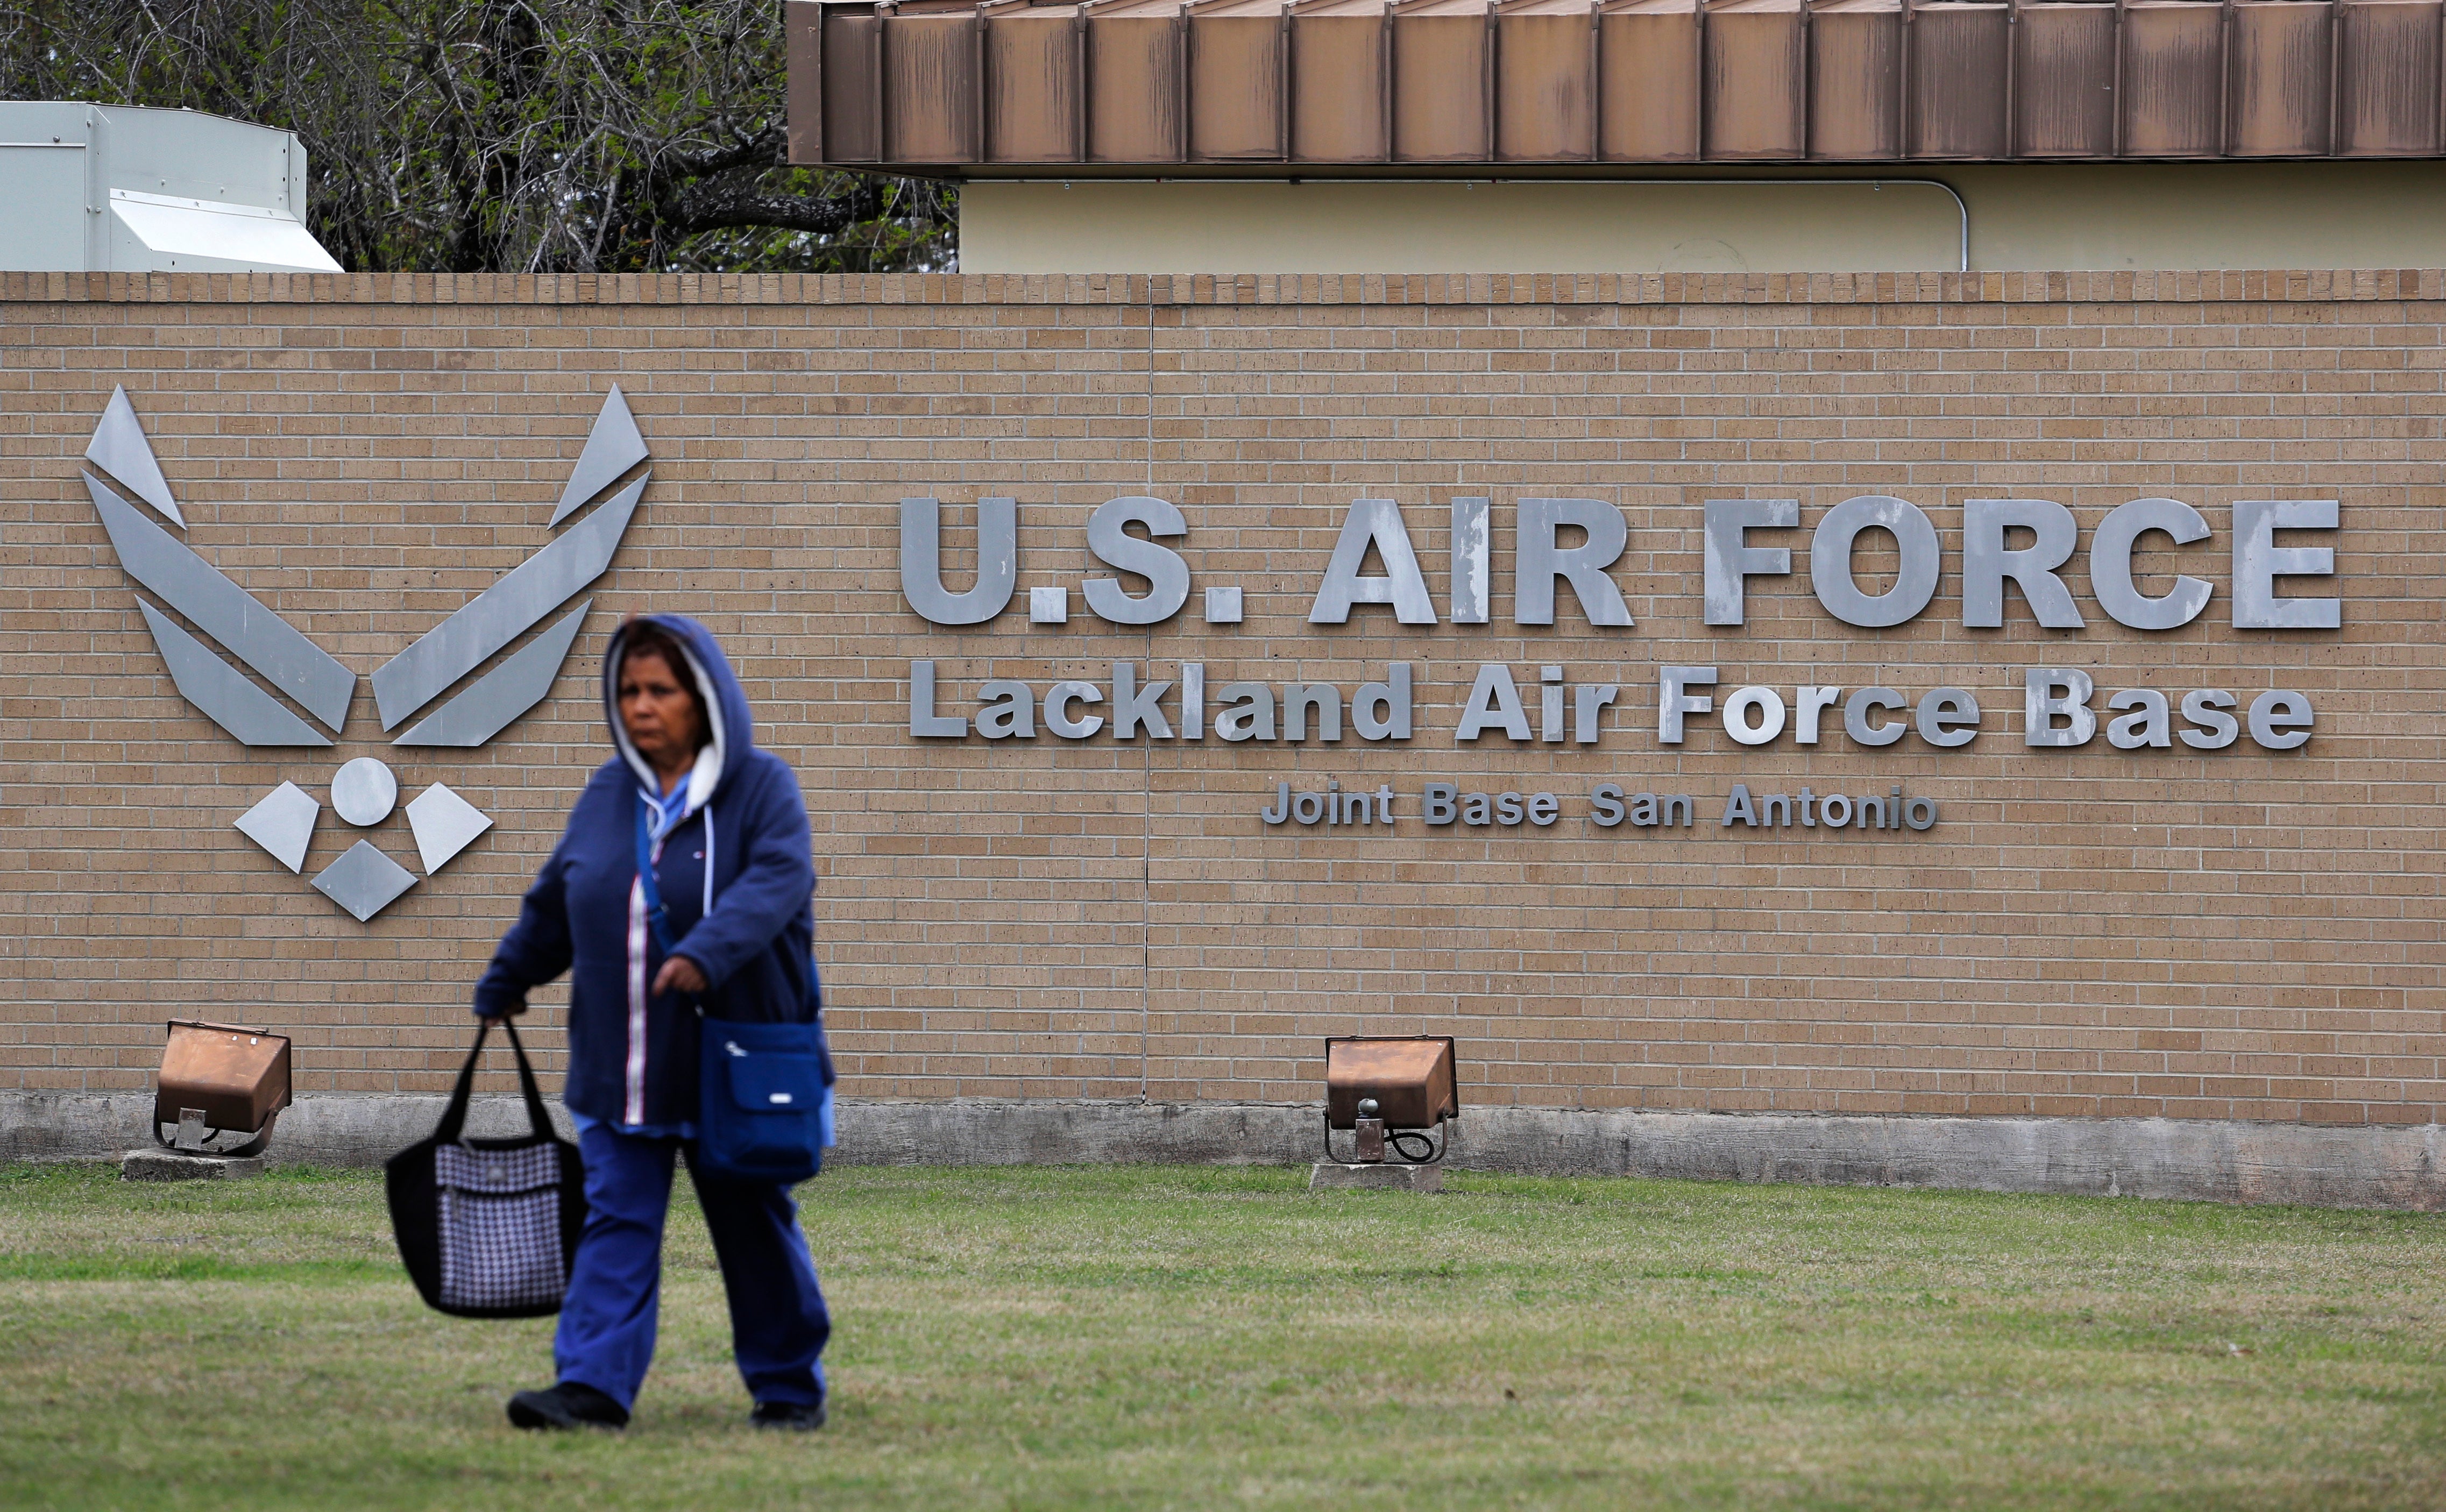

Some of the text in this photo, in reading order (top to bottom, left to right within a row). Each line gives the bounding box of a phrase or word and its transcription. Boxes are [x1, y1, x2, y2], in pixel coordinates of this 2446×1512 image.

[901, 495, 2341, 630] U.S. AIR FORCE
[909, 660, 2315, 750] Lackland Air Force Base
[1261, 782, 1938, 830] Joint Base San Antonio
